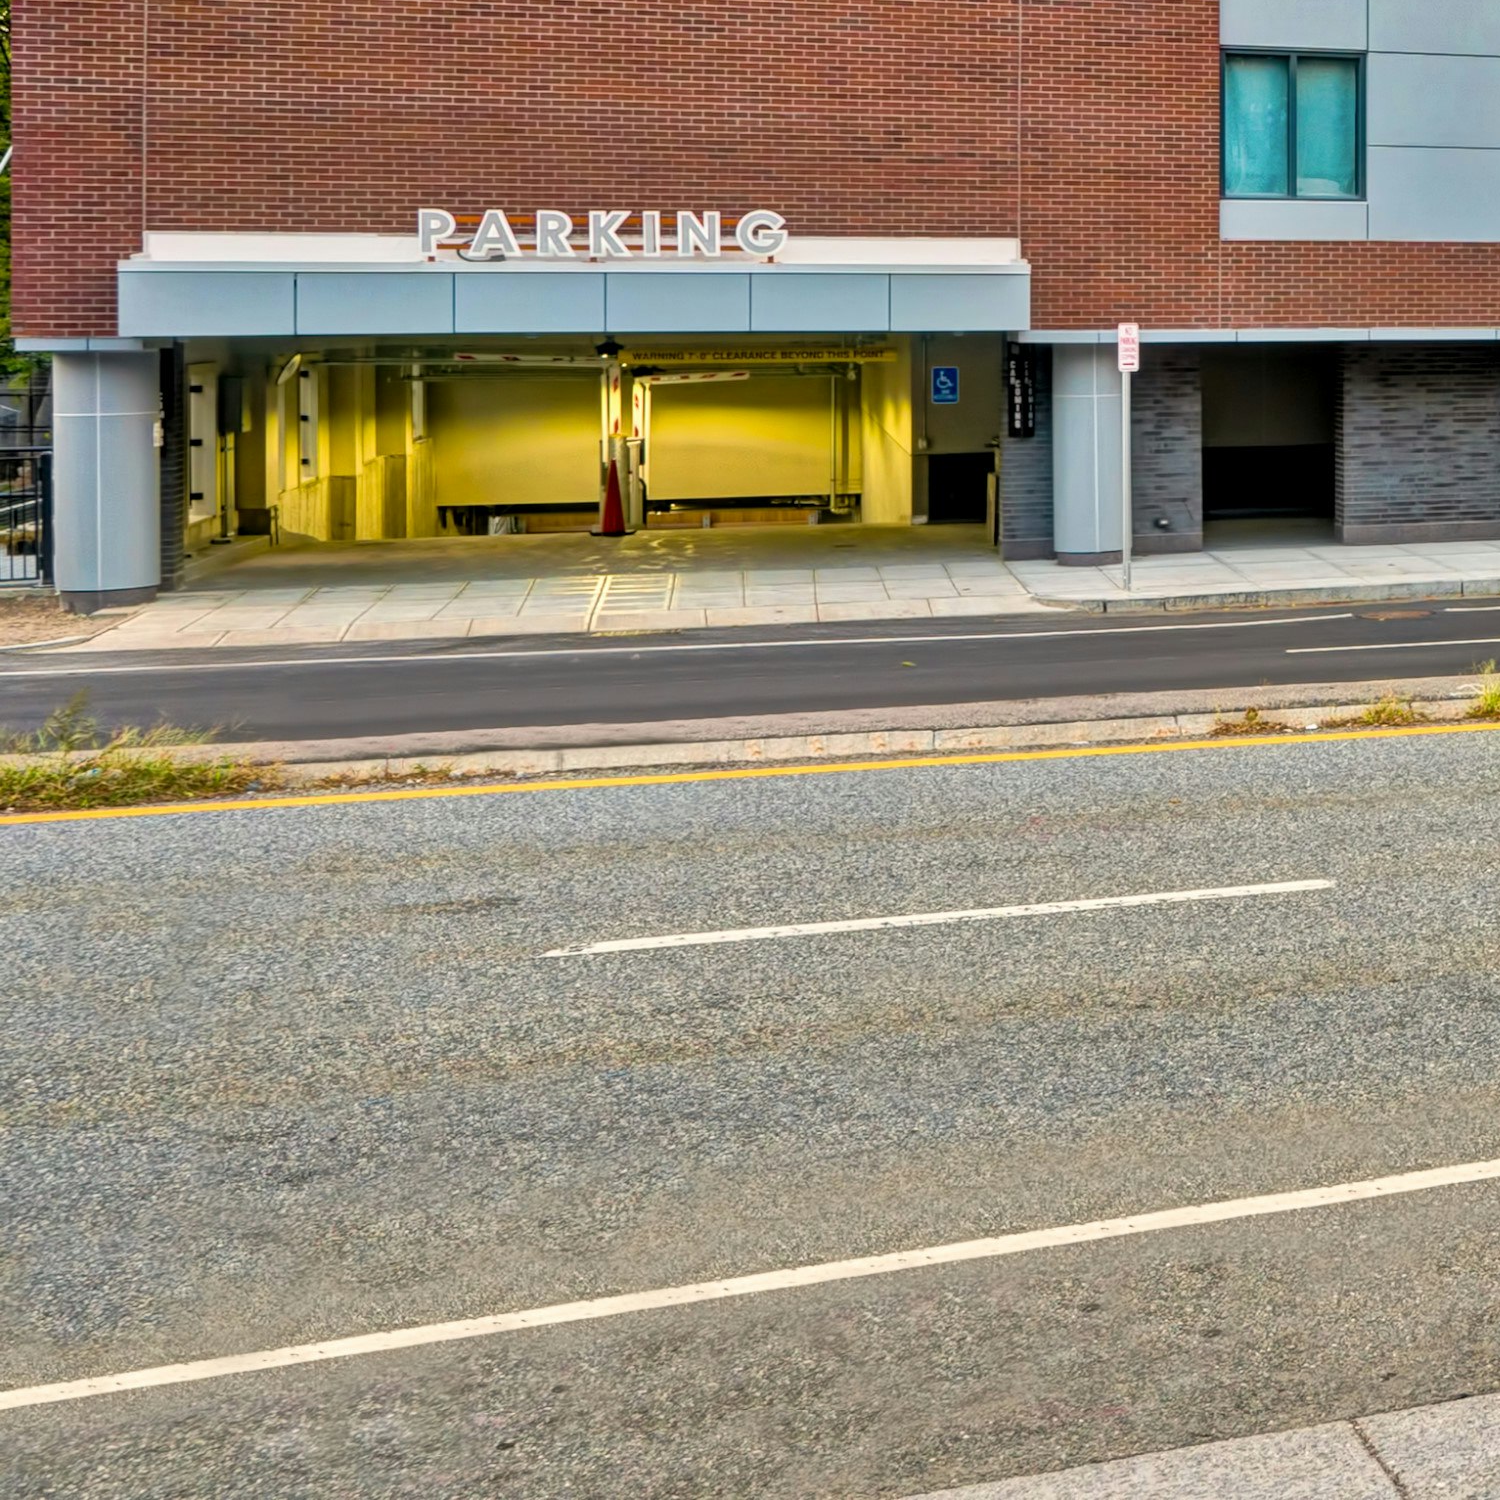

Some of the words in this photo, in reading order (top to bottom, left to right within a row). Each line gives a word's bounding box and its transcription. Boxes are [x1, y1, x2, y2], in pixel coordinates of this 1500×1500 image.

[417, 208, 789, 258] PARKING
[632, 351, 685, 360] WARNING
[713, 351, 778, 360] CLEARANCE
[780, 350, 824, 359] BEYOND
[826, 350, 850, 359] THIS
[853, 349, 885, 358] POINT
[1014, 379, 1022, 429] COMING
